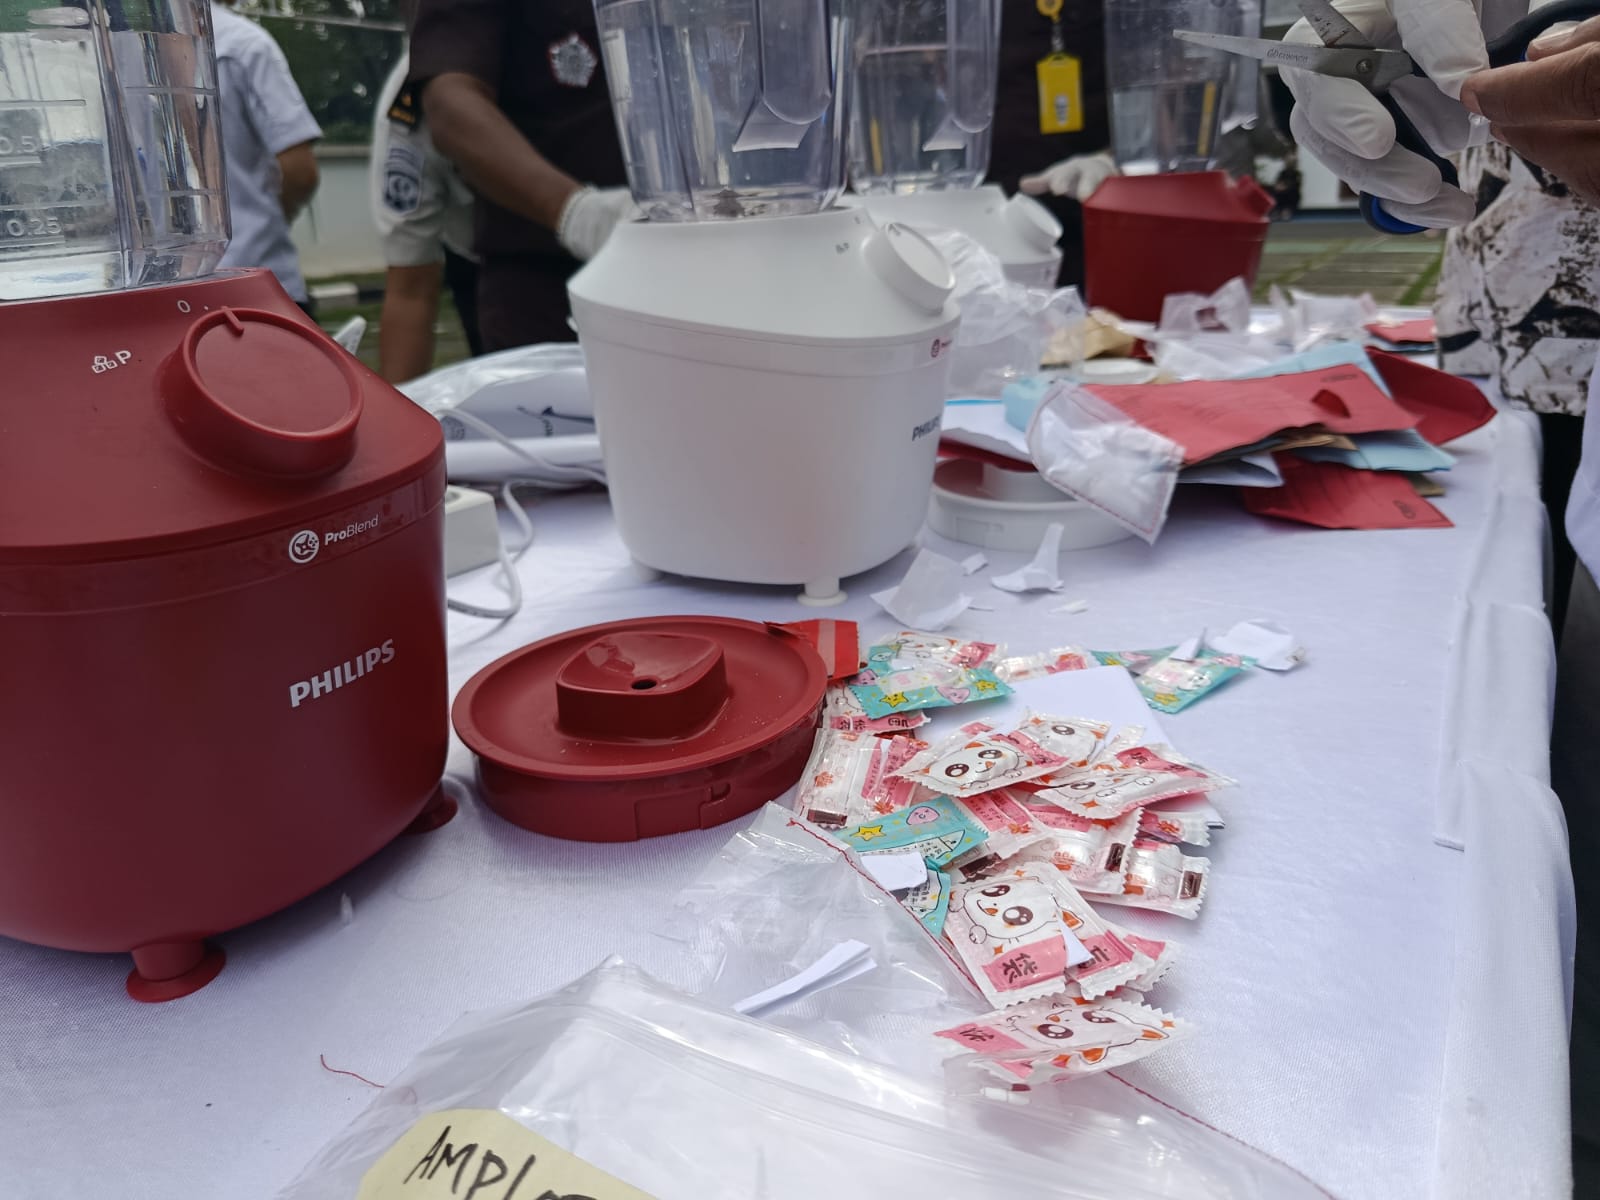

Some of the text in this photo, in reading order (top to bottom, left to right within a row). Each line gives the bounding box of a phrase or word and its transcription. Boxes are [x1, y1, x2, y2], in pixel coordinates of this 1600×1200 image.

[6, 215, 63, 237] 0.25
[114, 349, 132, 365] P
[323, 513, 380, 547] ProBlend
[288, 637, 396, 709] PHILIPS
